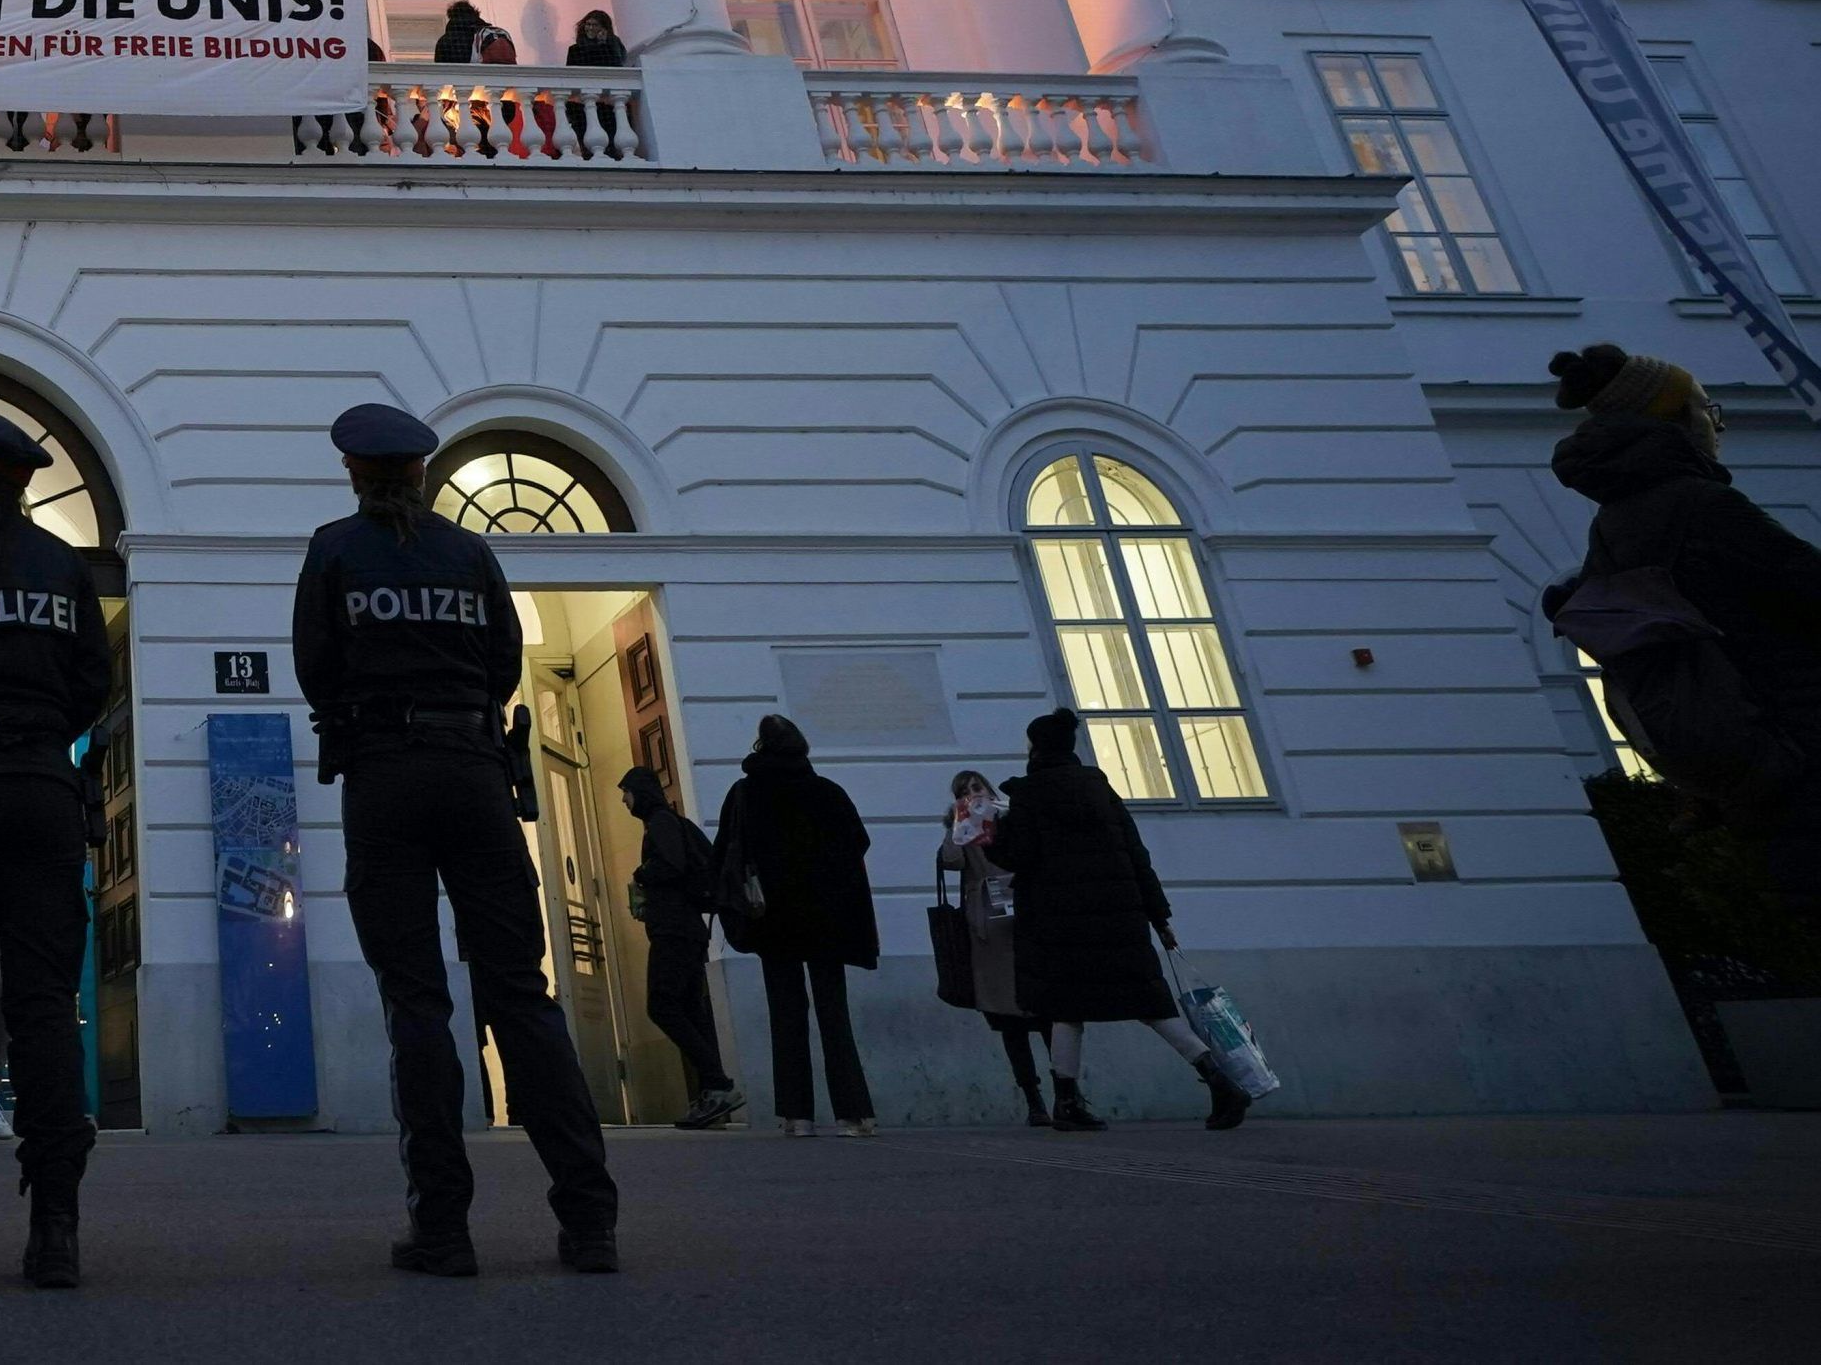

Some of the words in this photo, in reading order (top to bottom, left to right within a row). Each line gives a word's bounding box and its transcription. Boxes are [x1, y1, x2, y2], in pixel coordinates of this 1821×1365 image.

[43, 30, 104, 58] FÜR
[114, 33, 194, 58] FREIE
[204, 36, 346, 60] BILDUNG
[345, 586, 489, 626] POLIZEI
[229, 655, 253, 678] 13
